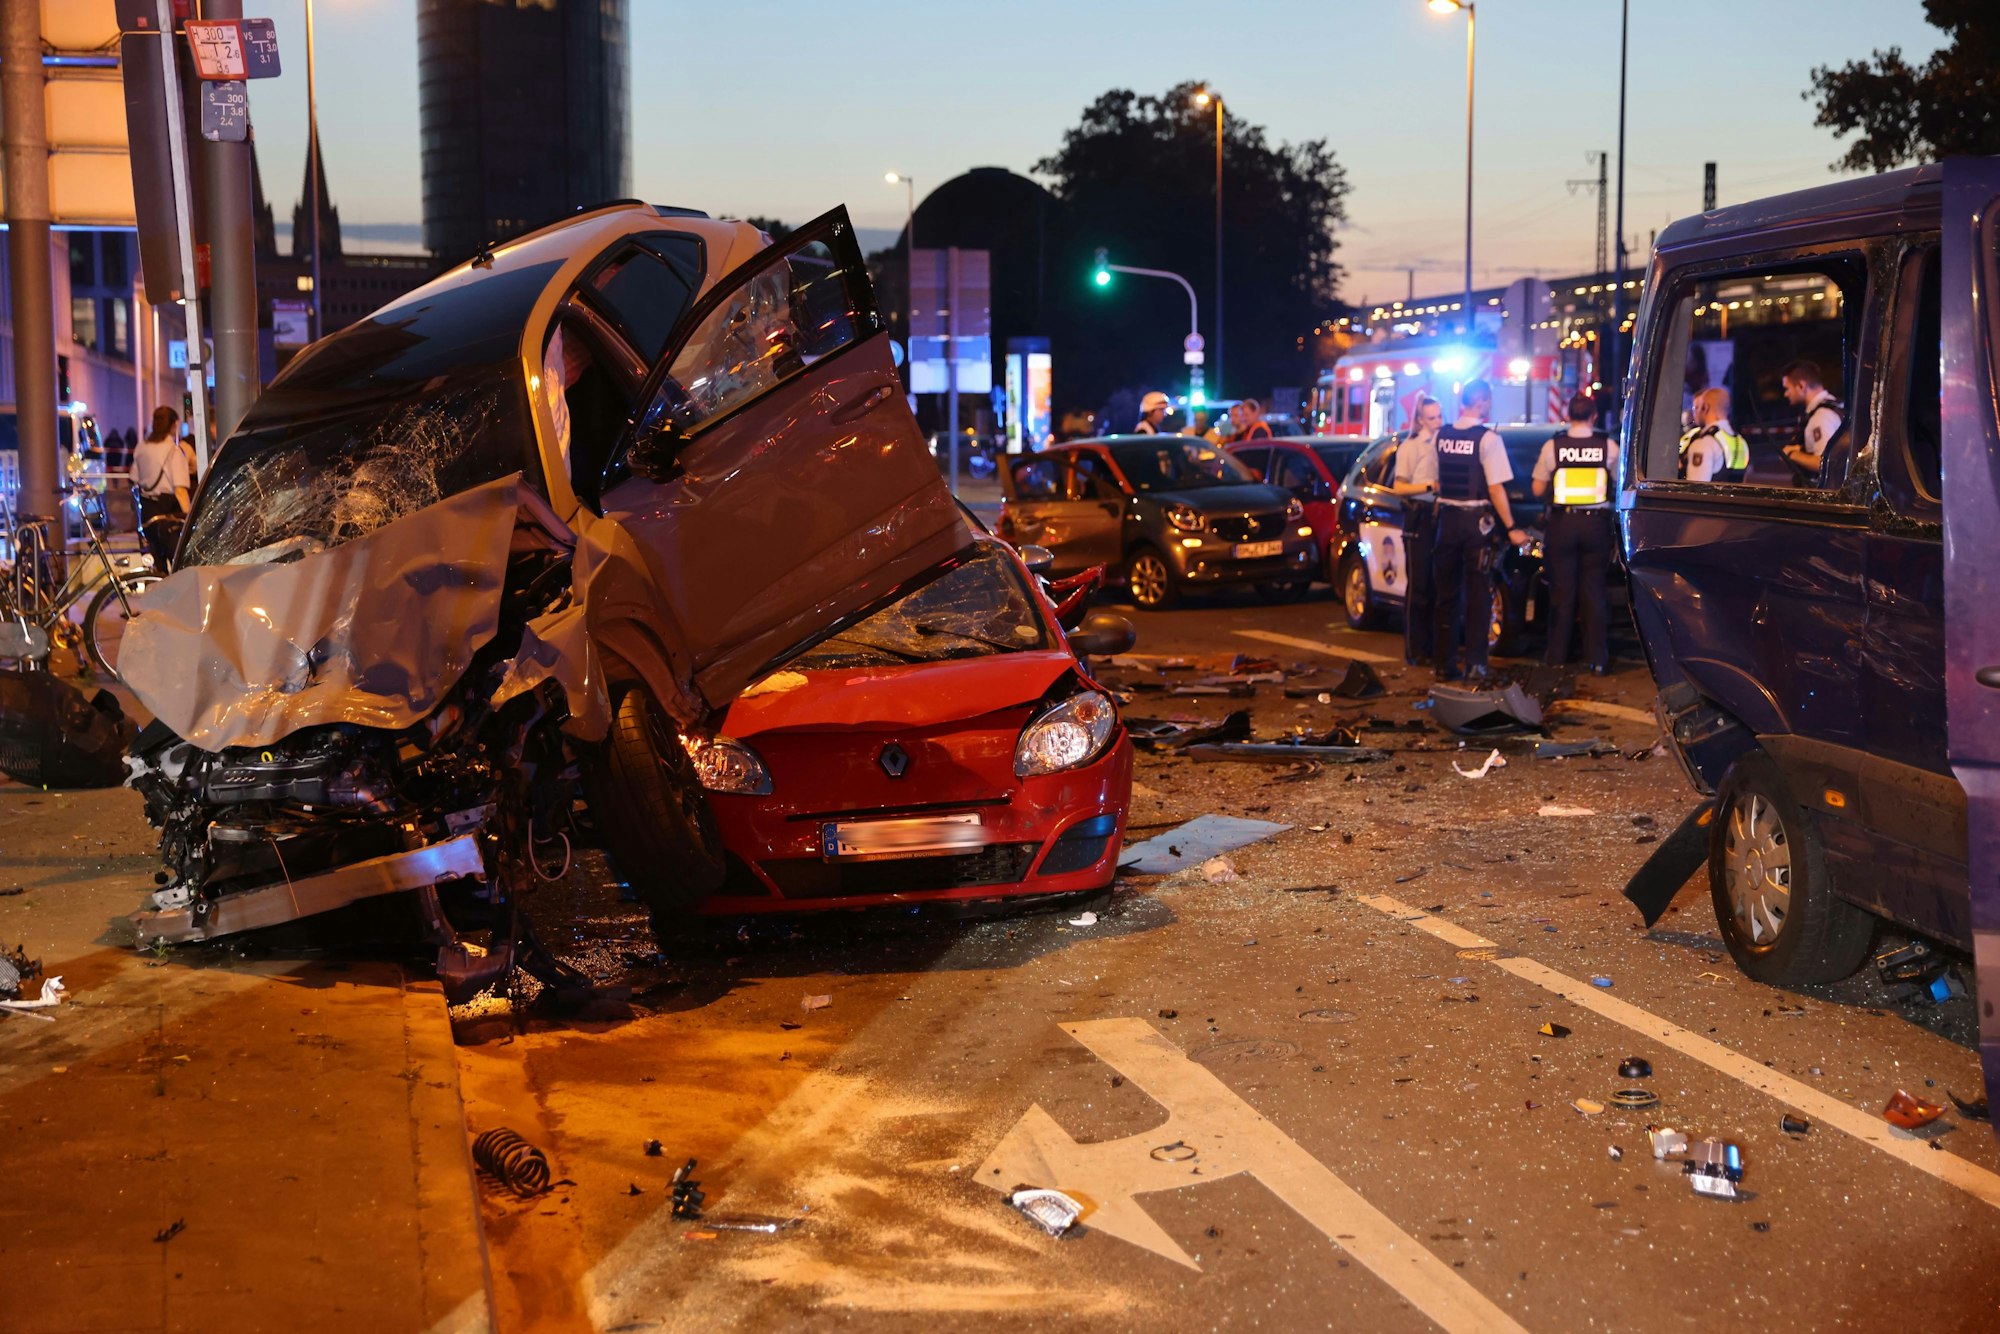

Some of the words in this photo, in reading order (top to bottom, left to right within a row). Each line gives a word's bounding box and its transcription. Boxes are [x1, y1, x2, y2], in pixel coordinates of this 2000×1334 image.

[192, 28, 200, 39] H
[204, 27, 224, 40] 300
[243, 31, 254, 41] VS
[266, 30, 275, 39] 80
[266, 43, 277, 53] 3.0
[260, 54, 271, 64] 3.1
[209, 93, 215, 102] S
[227, 94, 243, 103] 300
[230, 107, 243, 116] 3.8
[220, 117, 233, 126] 2.4
[1438, 438, 1474, 455] POLIZEI
[1559, 447, 1603, 463] POLIZEI
